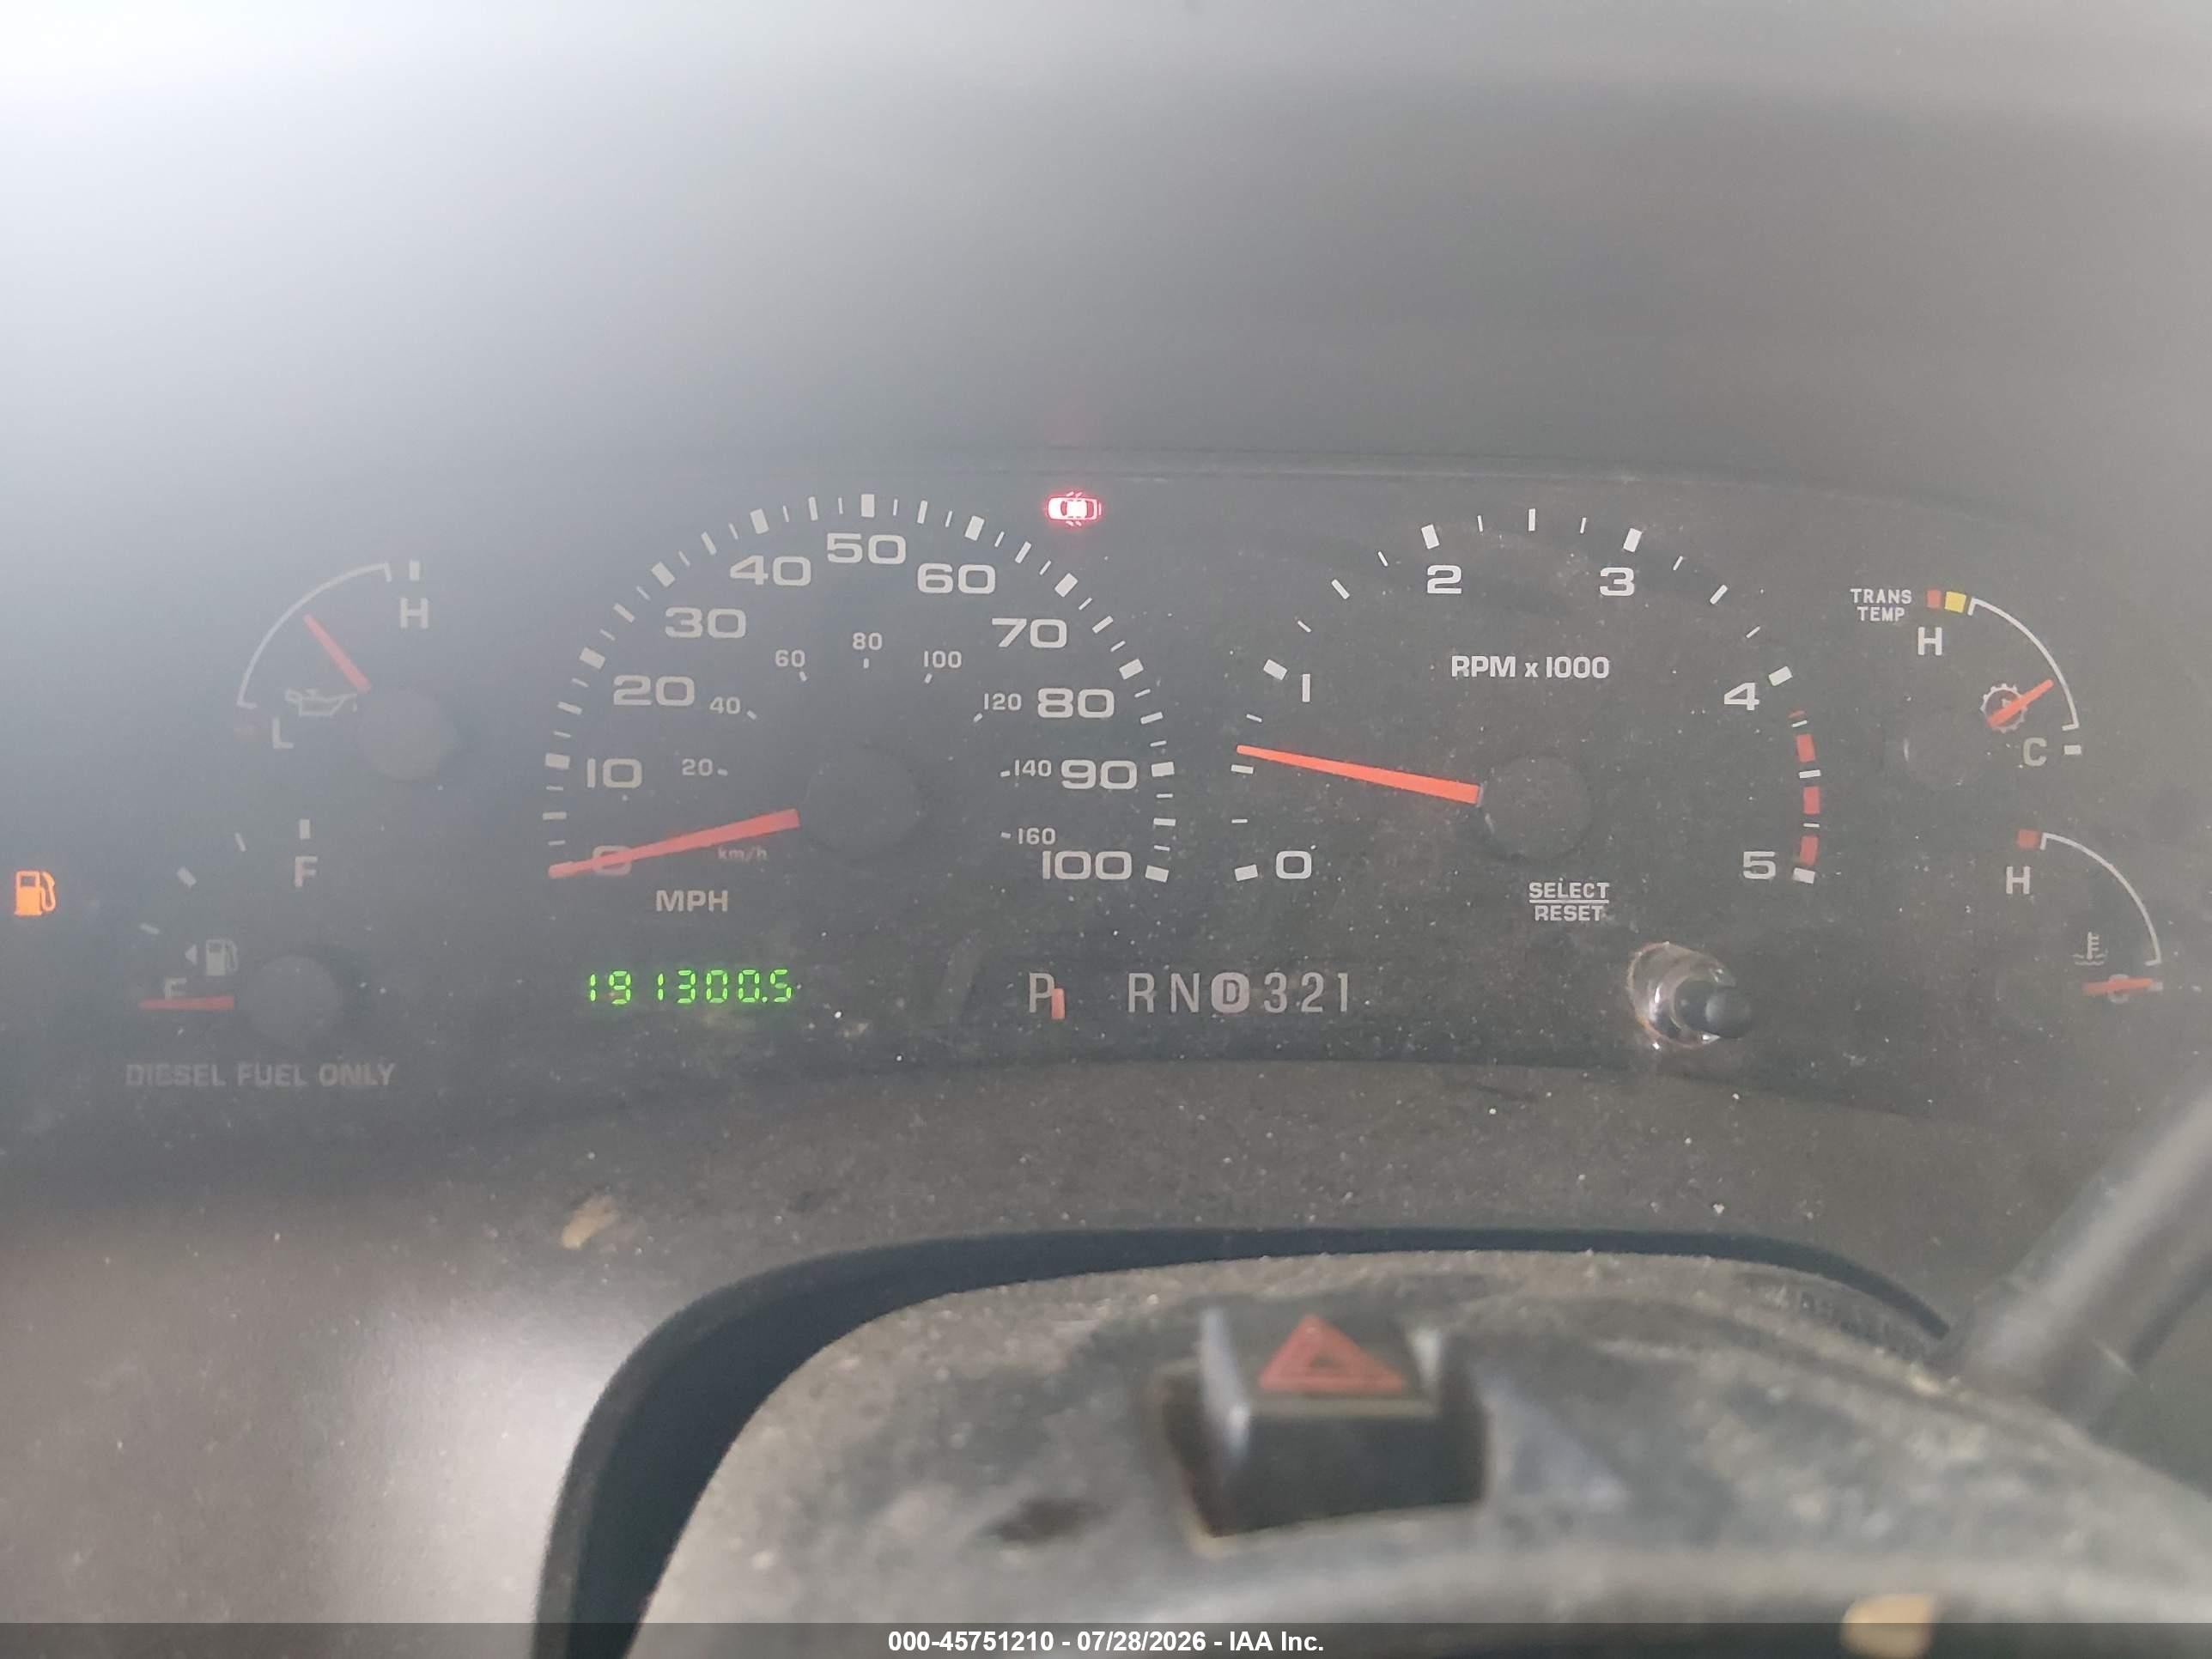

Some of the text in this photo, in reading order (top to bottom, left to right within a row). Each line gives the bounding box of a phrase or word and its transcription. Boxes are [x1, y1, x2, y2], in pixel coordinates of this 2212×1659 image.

[827, 532, 907, 564] 50
[730, 555, 811, 586] 40
[917, 562, 996, 594] 60
[1426, 564, 1462, 594] 2
[1600, 567, 1635, 596] 3
[1850, 588, 1912, 605] TRANS
[399, 598, 429, 629] H
[665, 606, 747, 639] 30
[1857, 606, 1905, 622] TEMP
[852, 632, 884, 651] 80
[992, 617, 1068, 648] 70
[1917, 627, 1942, 655] H
[775, 649, 806, 667] 60
[923, 650, 963, 669] 100
[1451, 656, 1610, 678] RPM x 1000
[613, 675, 696, 707] 20
[983, 692, 1022, 711] 120
[1301, 673, 1311, 703] 1
[1724, 683, 1759, 710] 4
[709, 696, 741, 714] 40
[1037, 688, 1115, 718] 80
[271, 717, 294, 749] L
[2022, 738, 2047, 766] C
[586, 758, 642, 788] 10
[682, 758, 714, 776] 20
[1014, 759, 1052, 778] 140
[1060, 759, 1138, 789] 90
[1018, 828, 1056, 846] 160
[717, 845, 768, 862] km/h
[1042, 851, 1133, 880] 100
[1275, 851, 1312, 879] 0
[1743, 851, 1776, 879] 5
[295, 855, 318, 887] F
[2006, 866, 2030, 894] H
[656, 890, 729, 912] MPH
[1528, 883, 1610, 899] SELECT
[1534, 906, 1604, 922] RESET
[1030, 973, 1055, 1013] P
[125, 1064, 396, 1087] DIESEL FUEL ONLY
